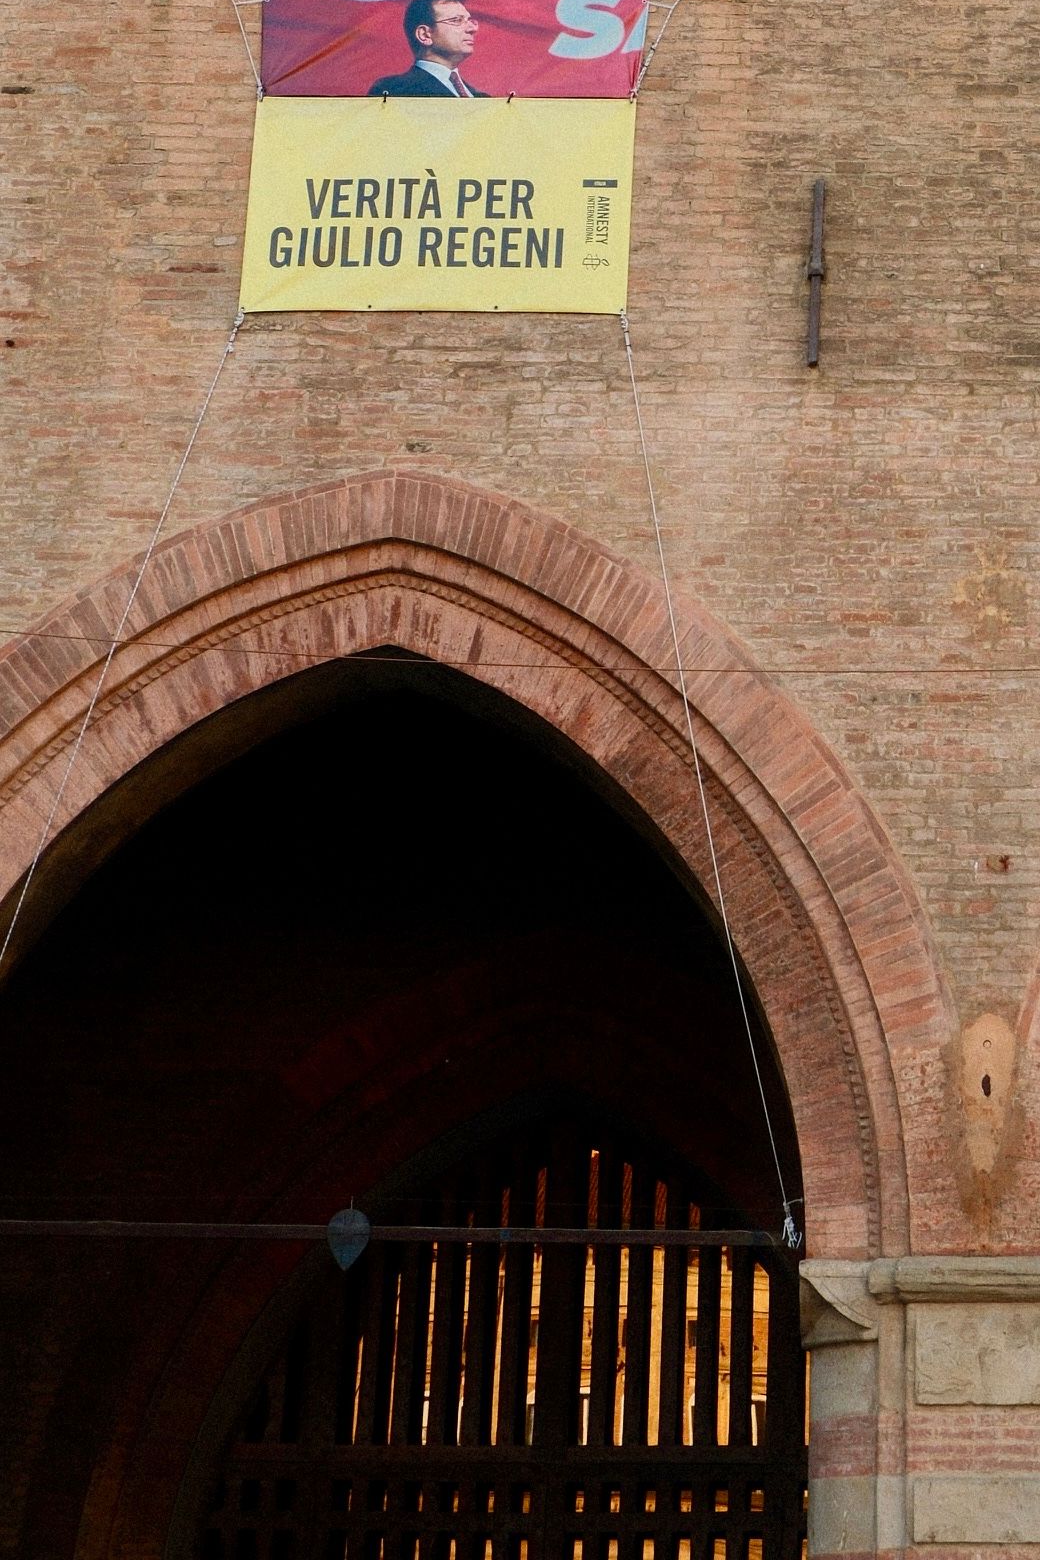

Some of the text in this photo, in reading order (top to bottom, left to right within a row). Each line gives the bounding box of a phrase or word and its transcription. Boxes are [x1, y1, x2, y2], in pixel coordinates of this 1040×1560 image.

[305, 168, 535, 220] VERITÀ PER
[585, 195, 595, 244] INTERNATIONAL
[596, 195, 610, 245] AMNESTY
[269, 226, 565, 268] GIULIO REGENI
